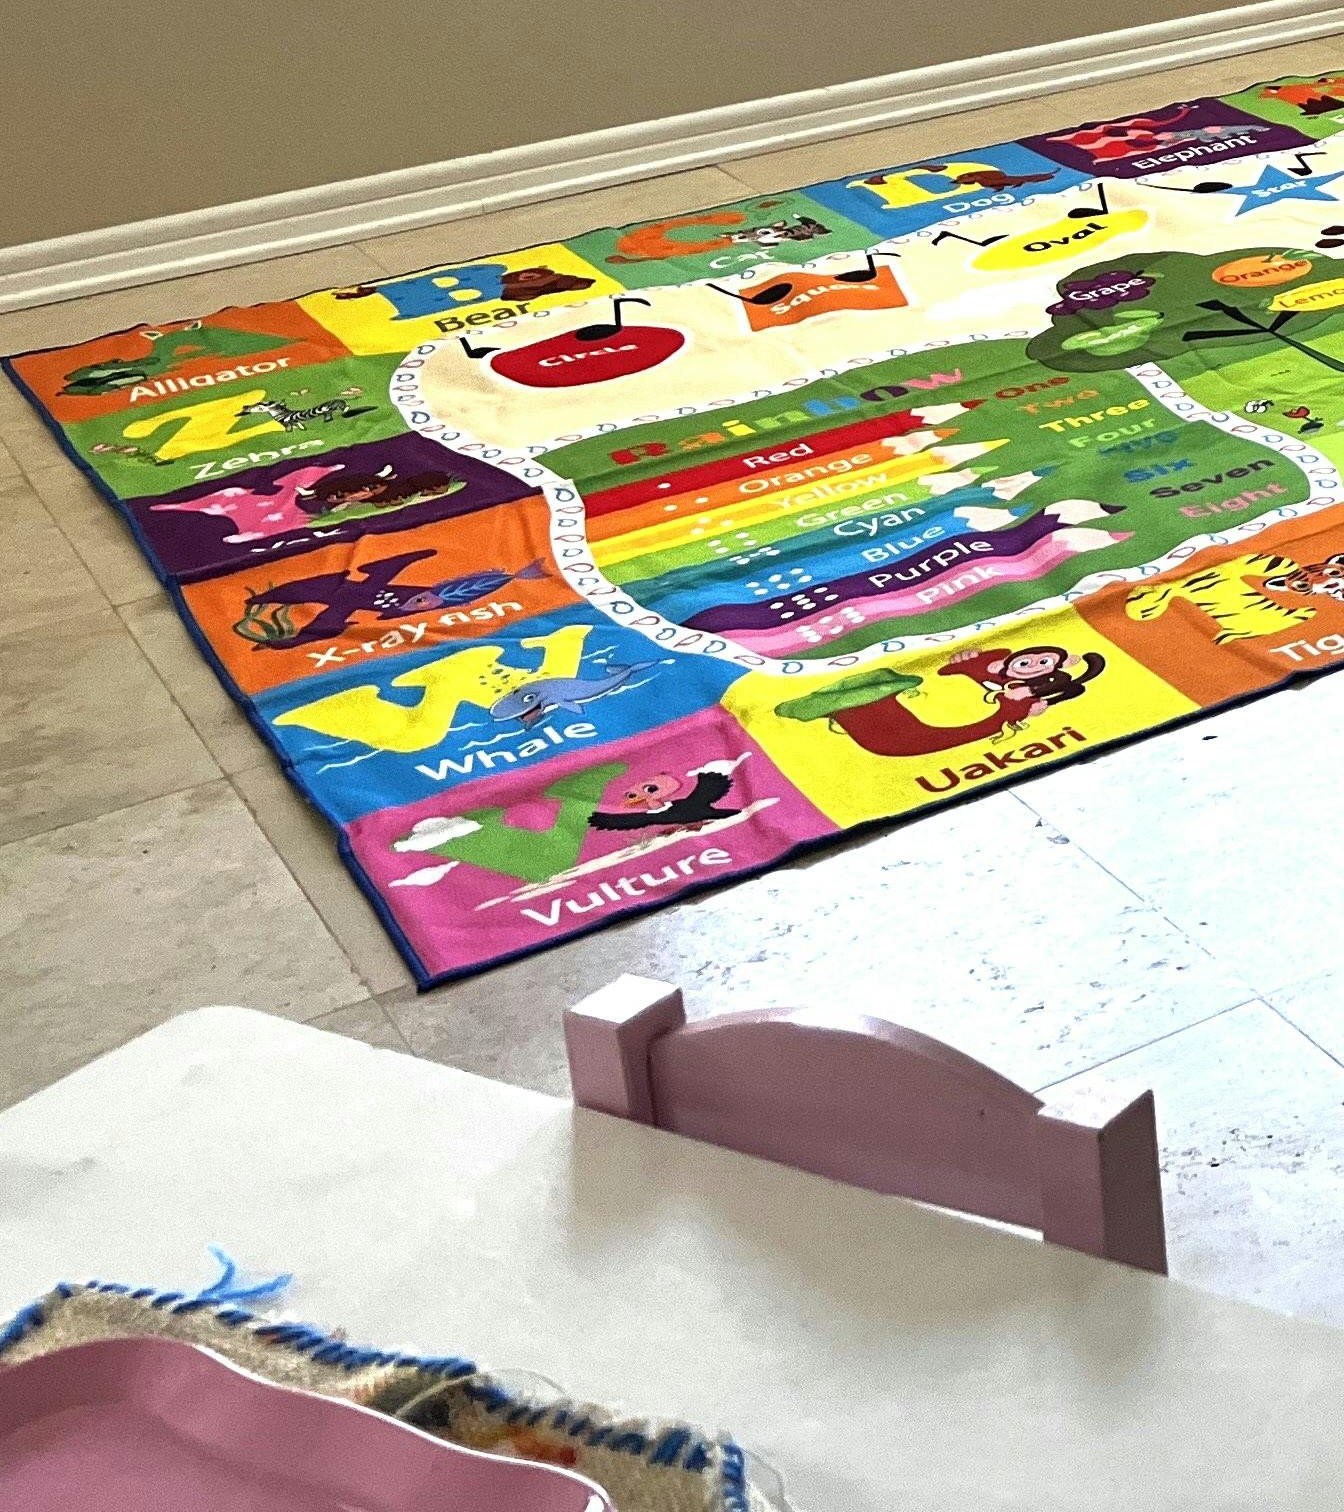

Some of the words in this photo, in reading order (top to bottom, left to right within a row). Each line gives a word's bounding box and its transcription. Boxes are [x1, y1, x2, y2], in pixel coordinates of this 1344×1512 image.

[1132, 132, 1258, 172] Elephant
[942, 191, 1015, 214] Dog
[1251, 177, 1308, 199] Star
[1023, 221, 1106, 252] Oval
[708, 245, 773, 272] Cat
[1220, 259, 1309, 284] Orange
[374, 264, 508, 321] B
[1068, 275, 1147, 302] Grape
[433, 300, 531, 334] Bear
[538, 341, 639, 368] Circle
[128, 353, 290, 403] Alligator
[996, 376, 1070, 400] One
[1017, 390, 1100, 415] Two
[1039, 399, 1151, 433] Three
[1068, 418, 1157, 448] Four
[739, 451, 872, 496] Orange
[742, 444, 813, 470] Red
[1123, 457, 1197, 483] Six
[775, 471, 890, 510] Yellow
[1150, 459, 1275, 498] Seven
[796, 489, 909, 529] Green
[1178, 482, 1287, 519] Eight
[833, 504, 926, 541] Cyan
[864, 522, 945, 564] Blue
[869, 539, 994, 589] Purple
[916, 563, 1004, 606] Pink
[306, 617, 429, 669] X-ray
[439, 596, 523, 631] fish
[274, 625, 593, 753] W
[415, 718, 598, 781] Whale
[914, 725, 1088, 793] Uakari
[419, 761, 628, 886] V
[521, 841, 734, 927] Vulture
